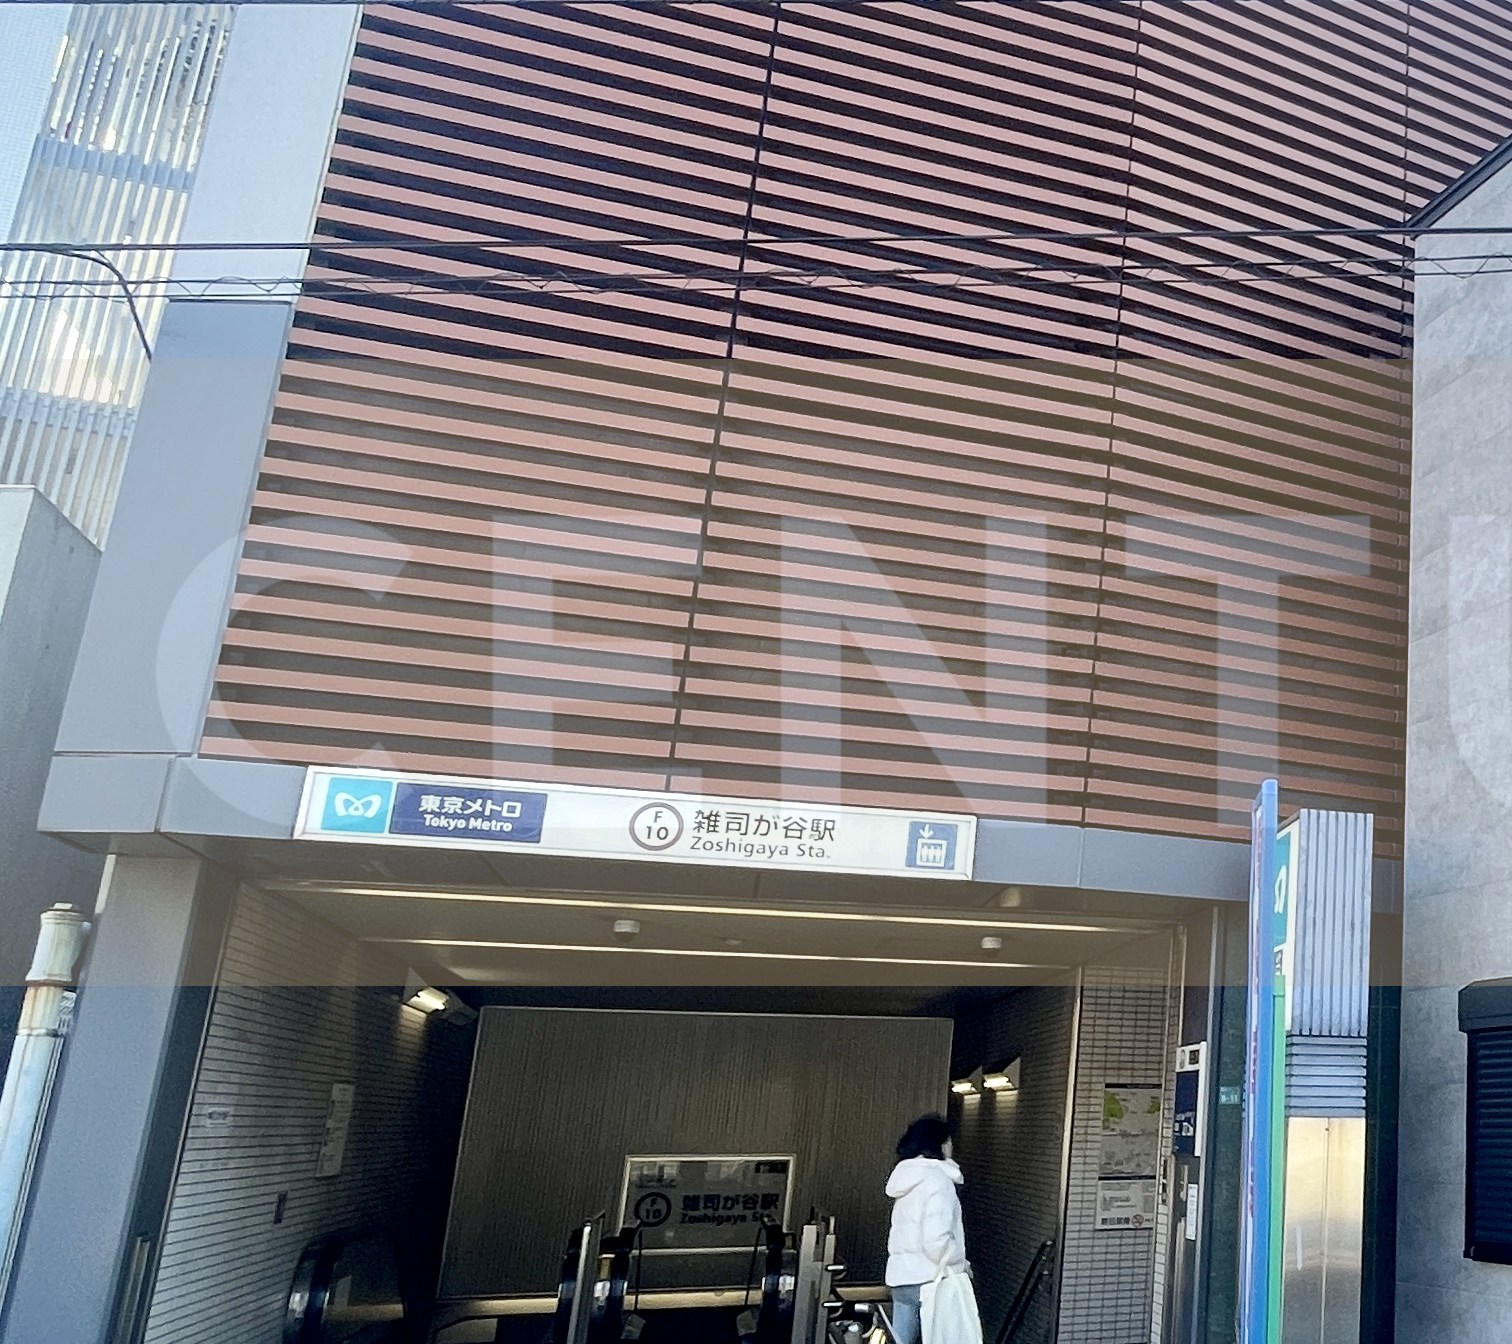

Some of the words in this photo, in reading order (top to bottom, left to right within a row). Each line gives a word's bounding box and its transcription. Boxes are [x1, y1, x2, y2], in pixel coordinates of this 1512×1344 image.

[418, 795, 522, 818] 東京メトロ
[654, 810, 663, 823] F
[423, 814, 467, 831] Tokyo
[468, 817, 513, 832] Metro
[692, 809, 836, 842] 雑司が谷駅
[646, 826, 669, 841] 10
[690, 836, 789, 859] Zoshigaya
[796, 843, 831, 859] Sta.
